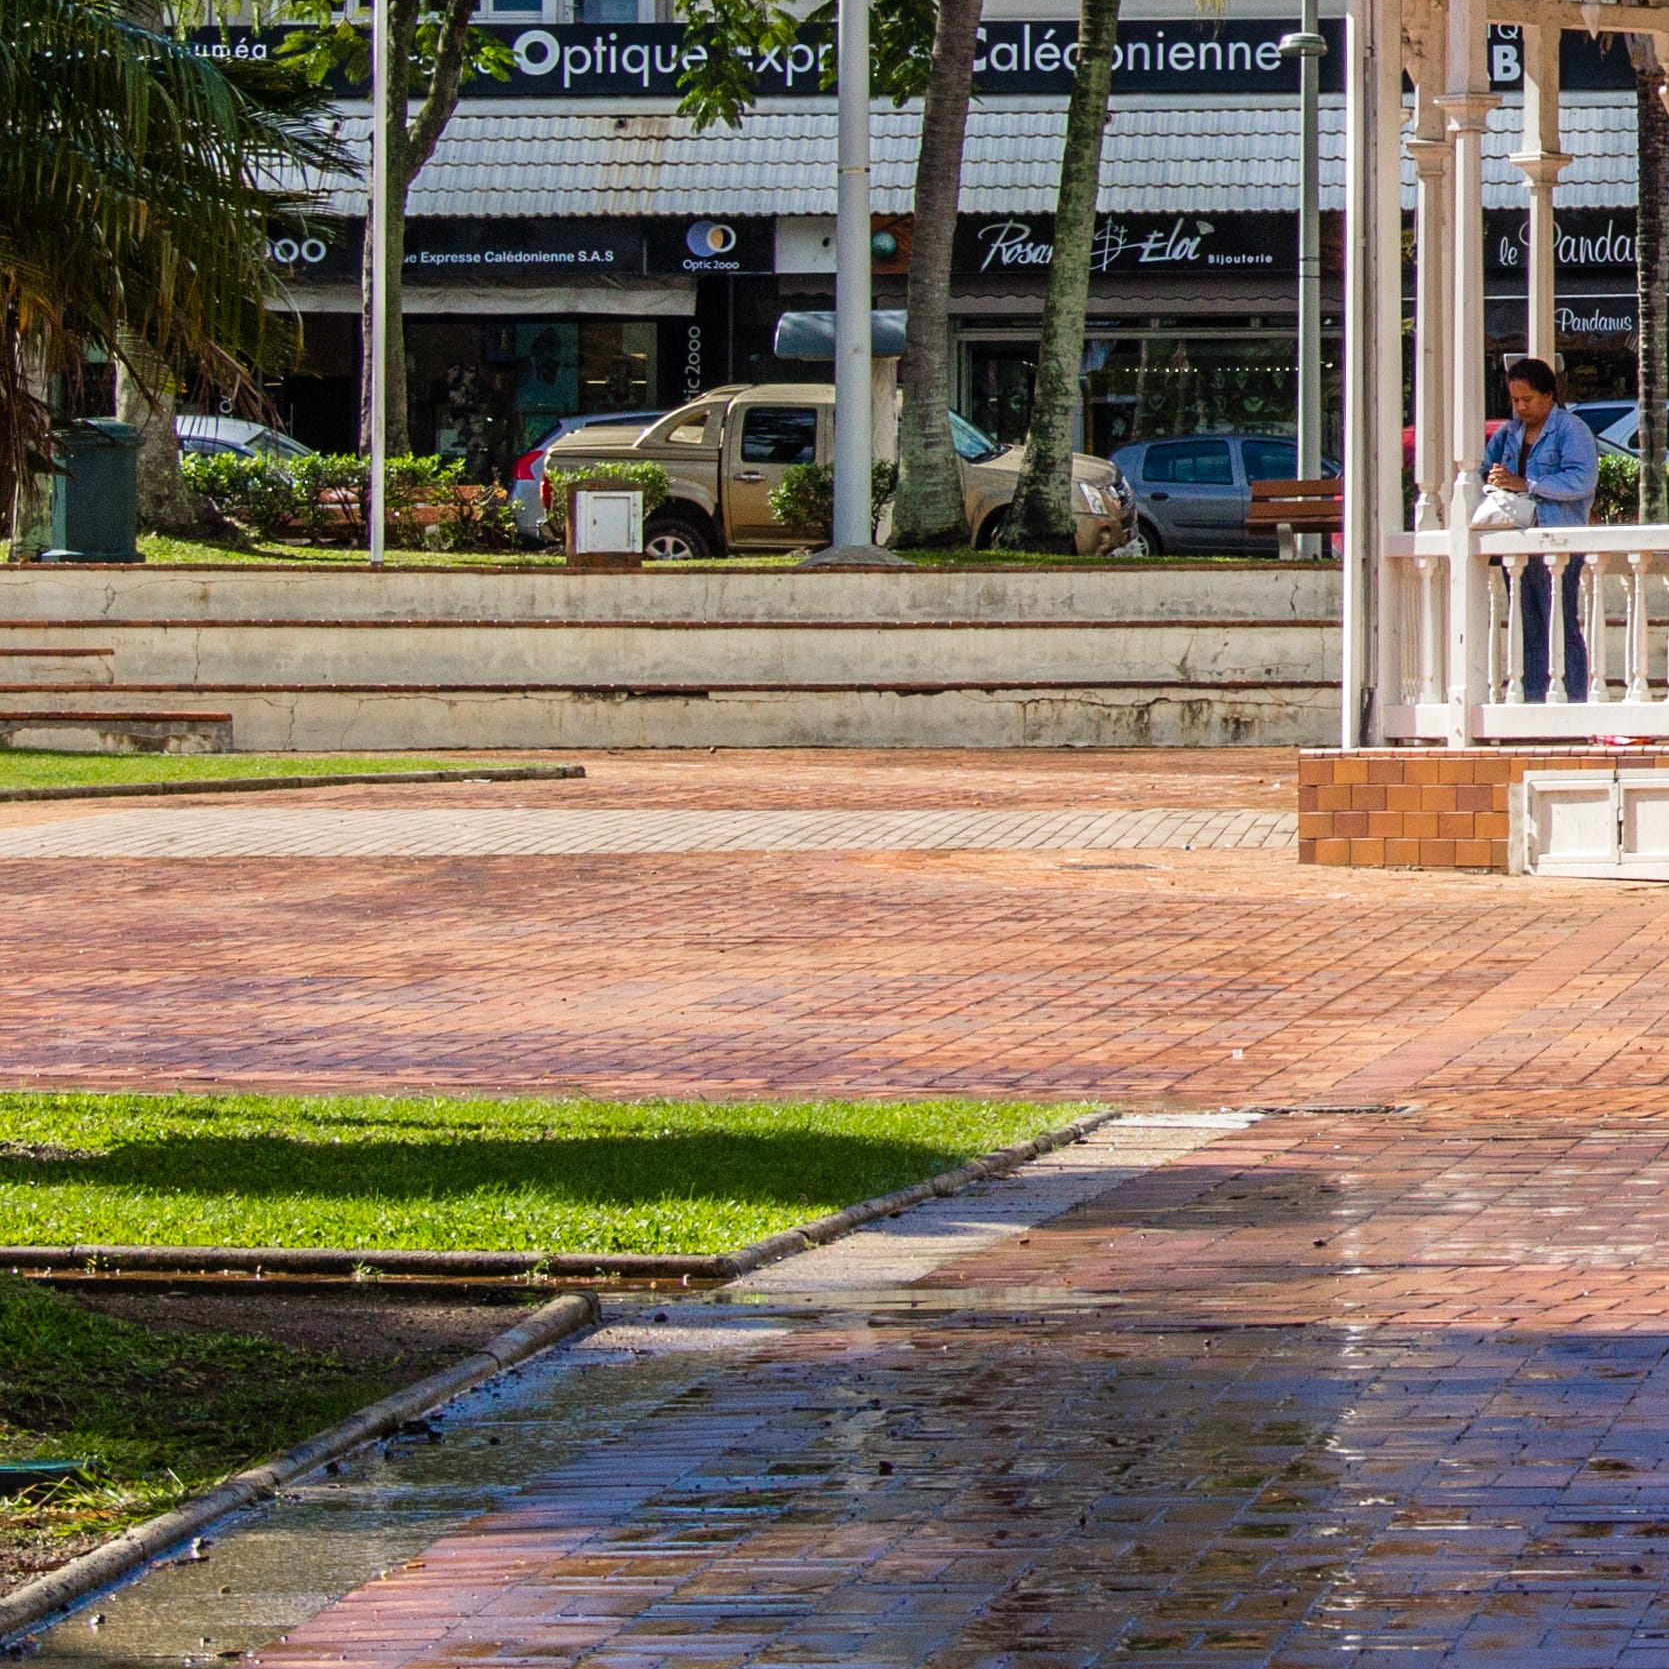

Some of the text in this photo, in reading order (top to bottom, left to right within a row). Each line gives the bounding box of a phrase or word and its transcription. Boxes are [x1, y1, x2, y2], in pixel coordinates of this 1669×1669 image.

[513, 30, 709, 88] Optique
[420, 250, 481, 266] Expresse
[484, 249, 575, 264] Calédonienne
[578, 250, 614, 263] S.A.S
[1208, 253, 1273, 266] Bijouterie
[1498, 236, 1518, 266] le
[682, 259, 712, 272] Optic
[1554, 307, 1633, 332] Pandanus
